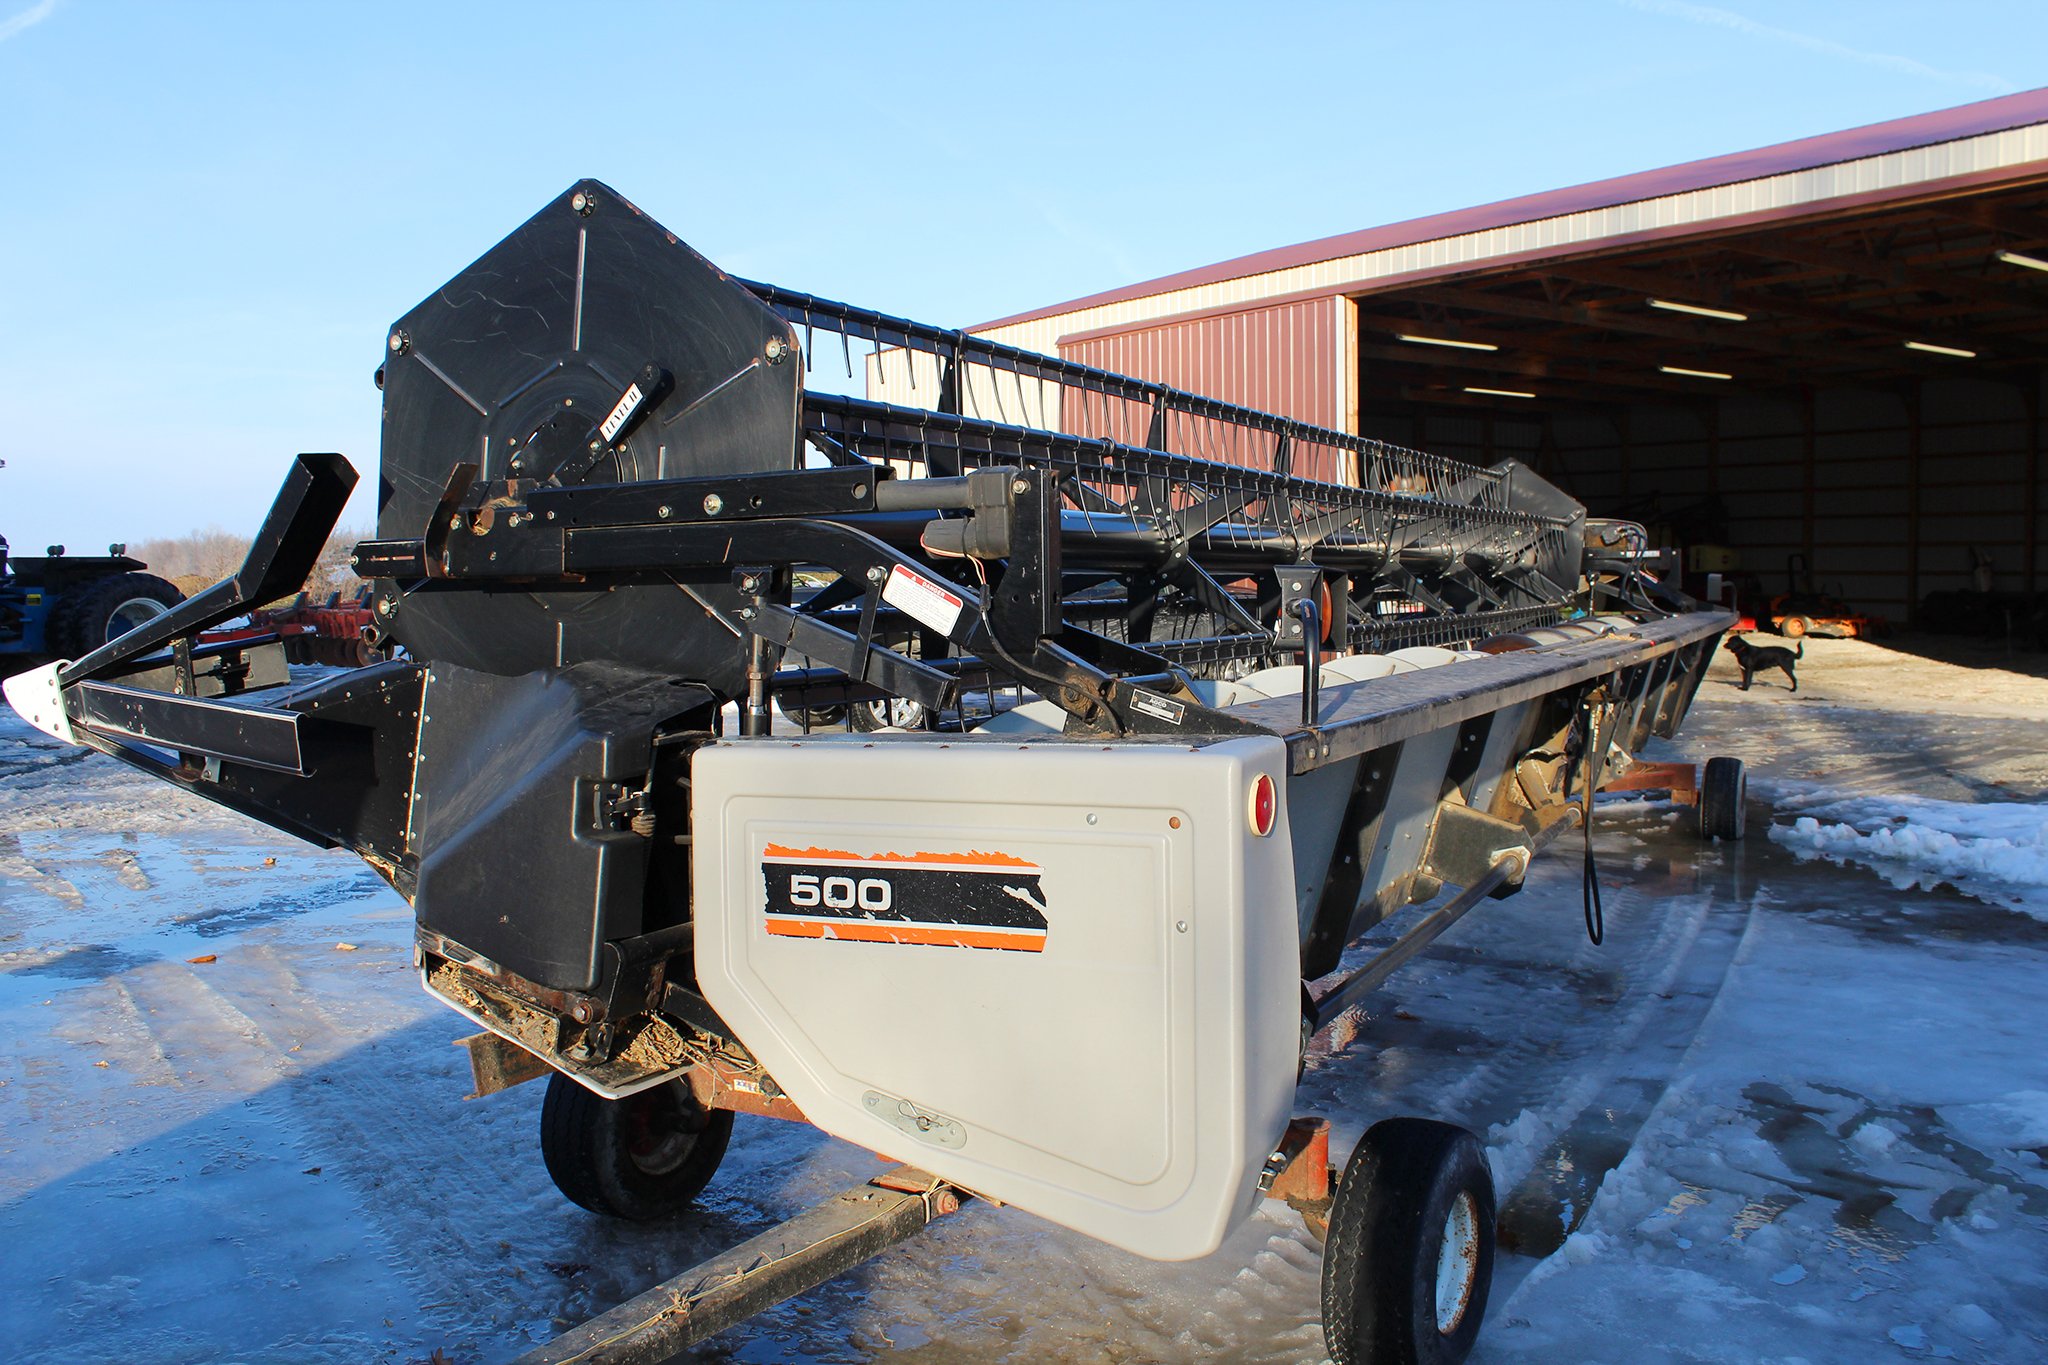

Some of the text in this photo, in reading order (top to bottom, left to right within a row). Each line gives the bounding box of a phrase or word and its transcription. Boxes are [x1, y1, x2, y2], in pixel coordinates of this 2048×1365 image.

[605, 402, 631, 434] LEVEL
[921, 581, 946, 599] DANGER
[1149, 697, 1167, 708] AGCO
[790, 874, 892, 912] 500
